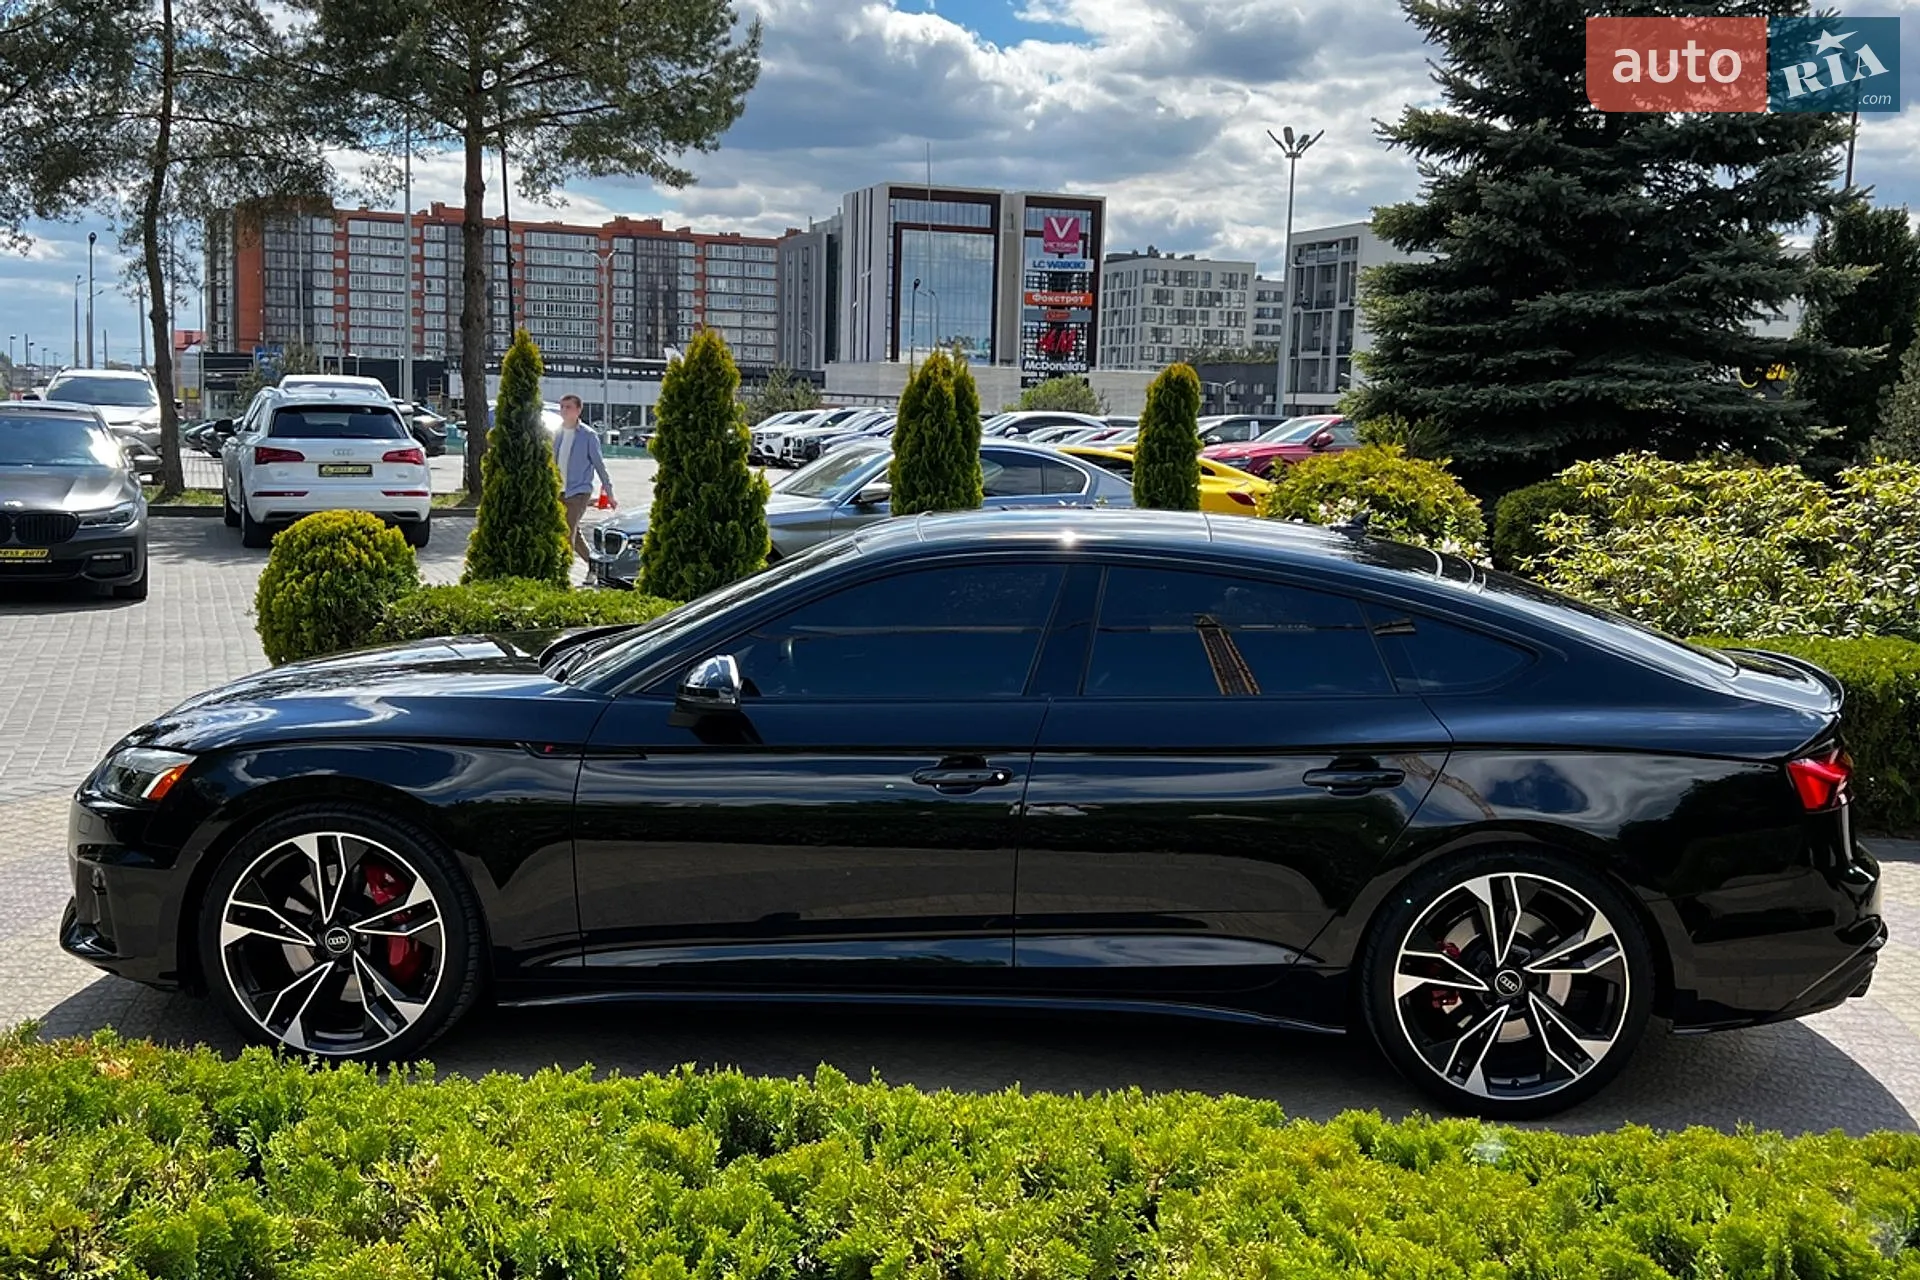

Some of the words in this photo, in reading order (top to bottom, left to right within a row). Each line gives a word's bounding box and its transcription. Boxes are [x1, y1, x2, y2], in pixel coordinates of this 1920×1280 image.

[1050, 217, 1075, 239] V
[1032, 260, 1045, 268] LC
[1032, 293, 1085, 304] Фокстрот
[1024, 361, 1087, 371] McDonald's
